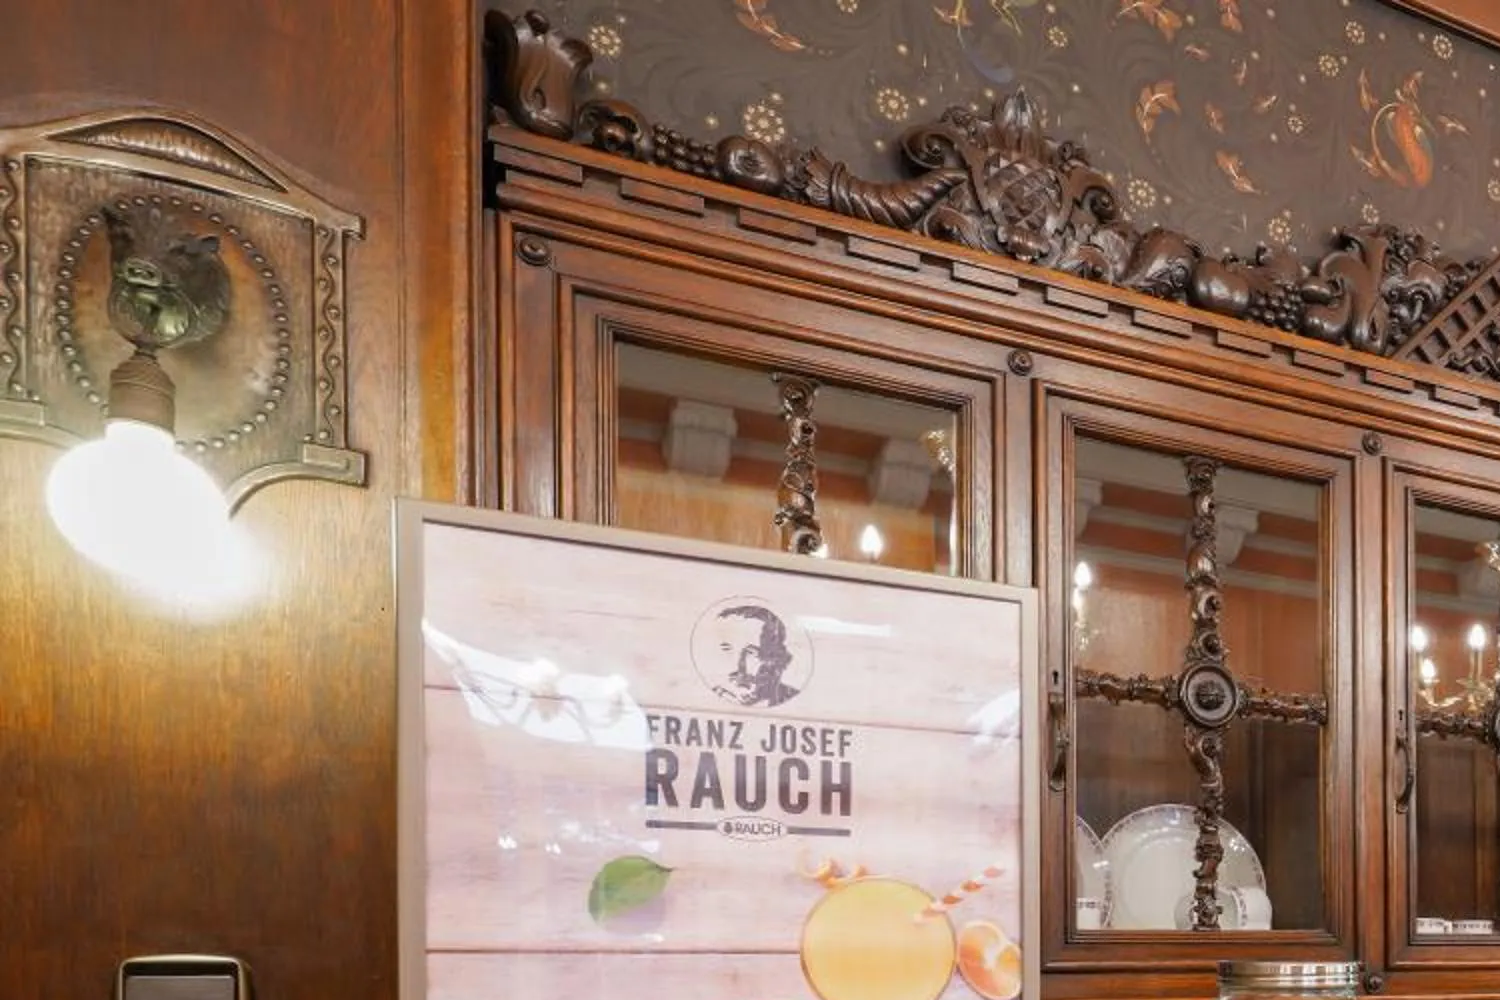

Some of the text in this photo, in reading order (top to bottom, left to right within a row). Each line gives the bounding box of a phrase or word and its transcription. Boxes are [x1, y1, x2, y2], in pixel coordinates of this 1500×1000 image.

[646, 715, 853, 757] FRANZ JOSEF
[645, 748, 852, 816] RAUCH
[735, 821, 782, 836] RAUCH
